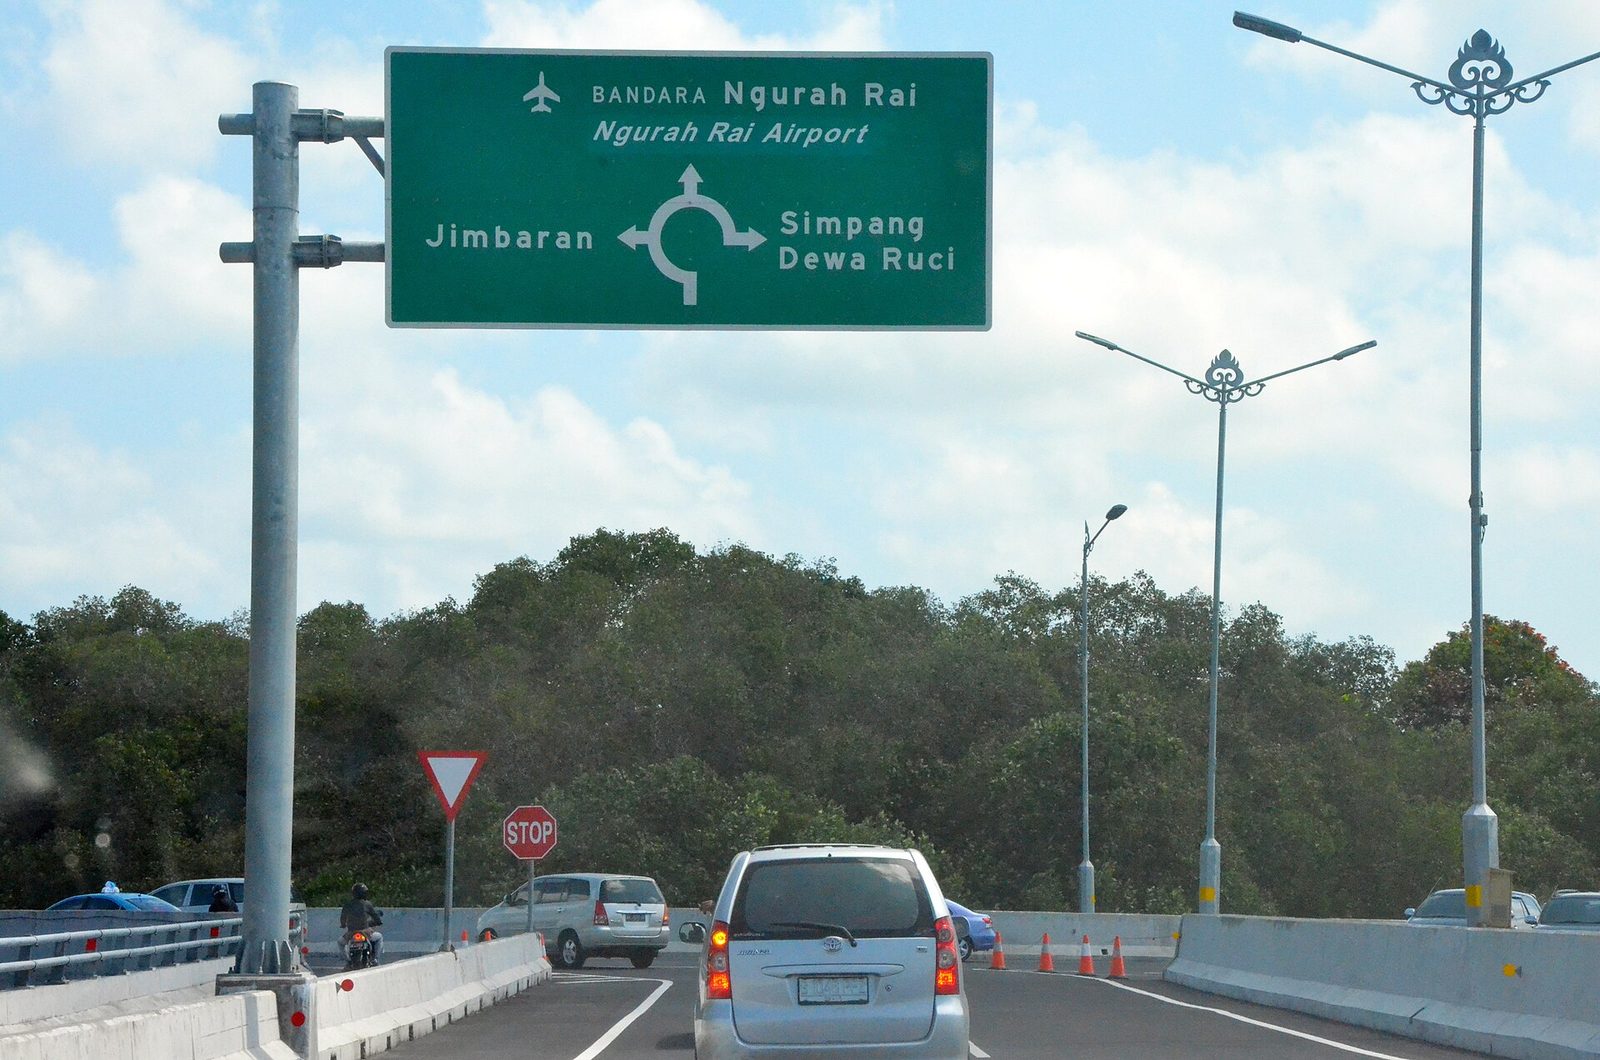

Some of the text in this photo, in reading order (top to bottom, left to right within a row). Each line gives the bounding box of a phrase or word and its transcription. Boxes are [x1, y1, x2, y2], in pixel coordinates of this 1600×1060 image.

[594, 81, 917, 111] BANDARA Ngurah Rai
[593, 121, 869, 148] Ngurah Rai Airport
[425, 223, 592, 249] Jimbaran
[780, 211, 924, 242] Simpang
[779, 246, 954, 270] Dewa Ruci
[507, 821, 553, 844] STOP
